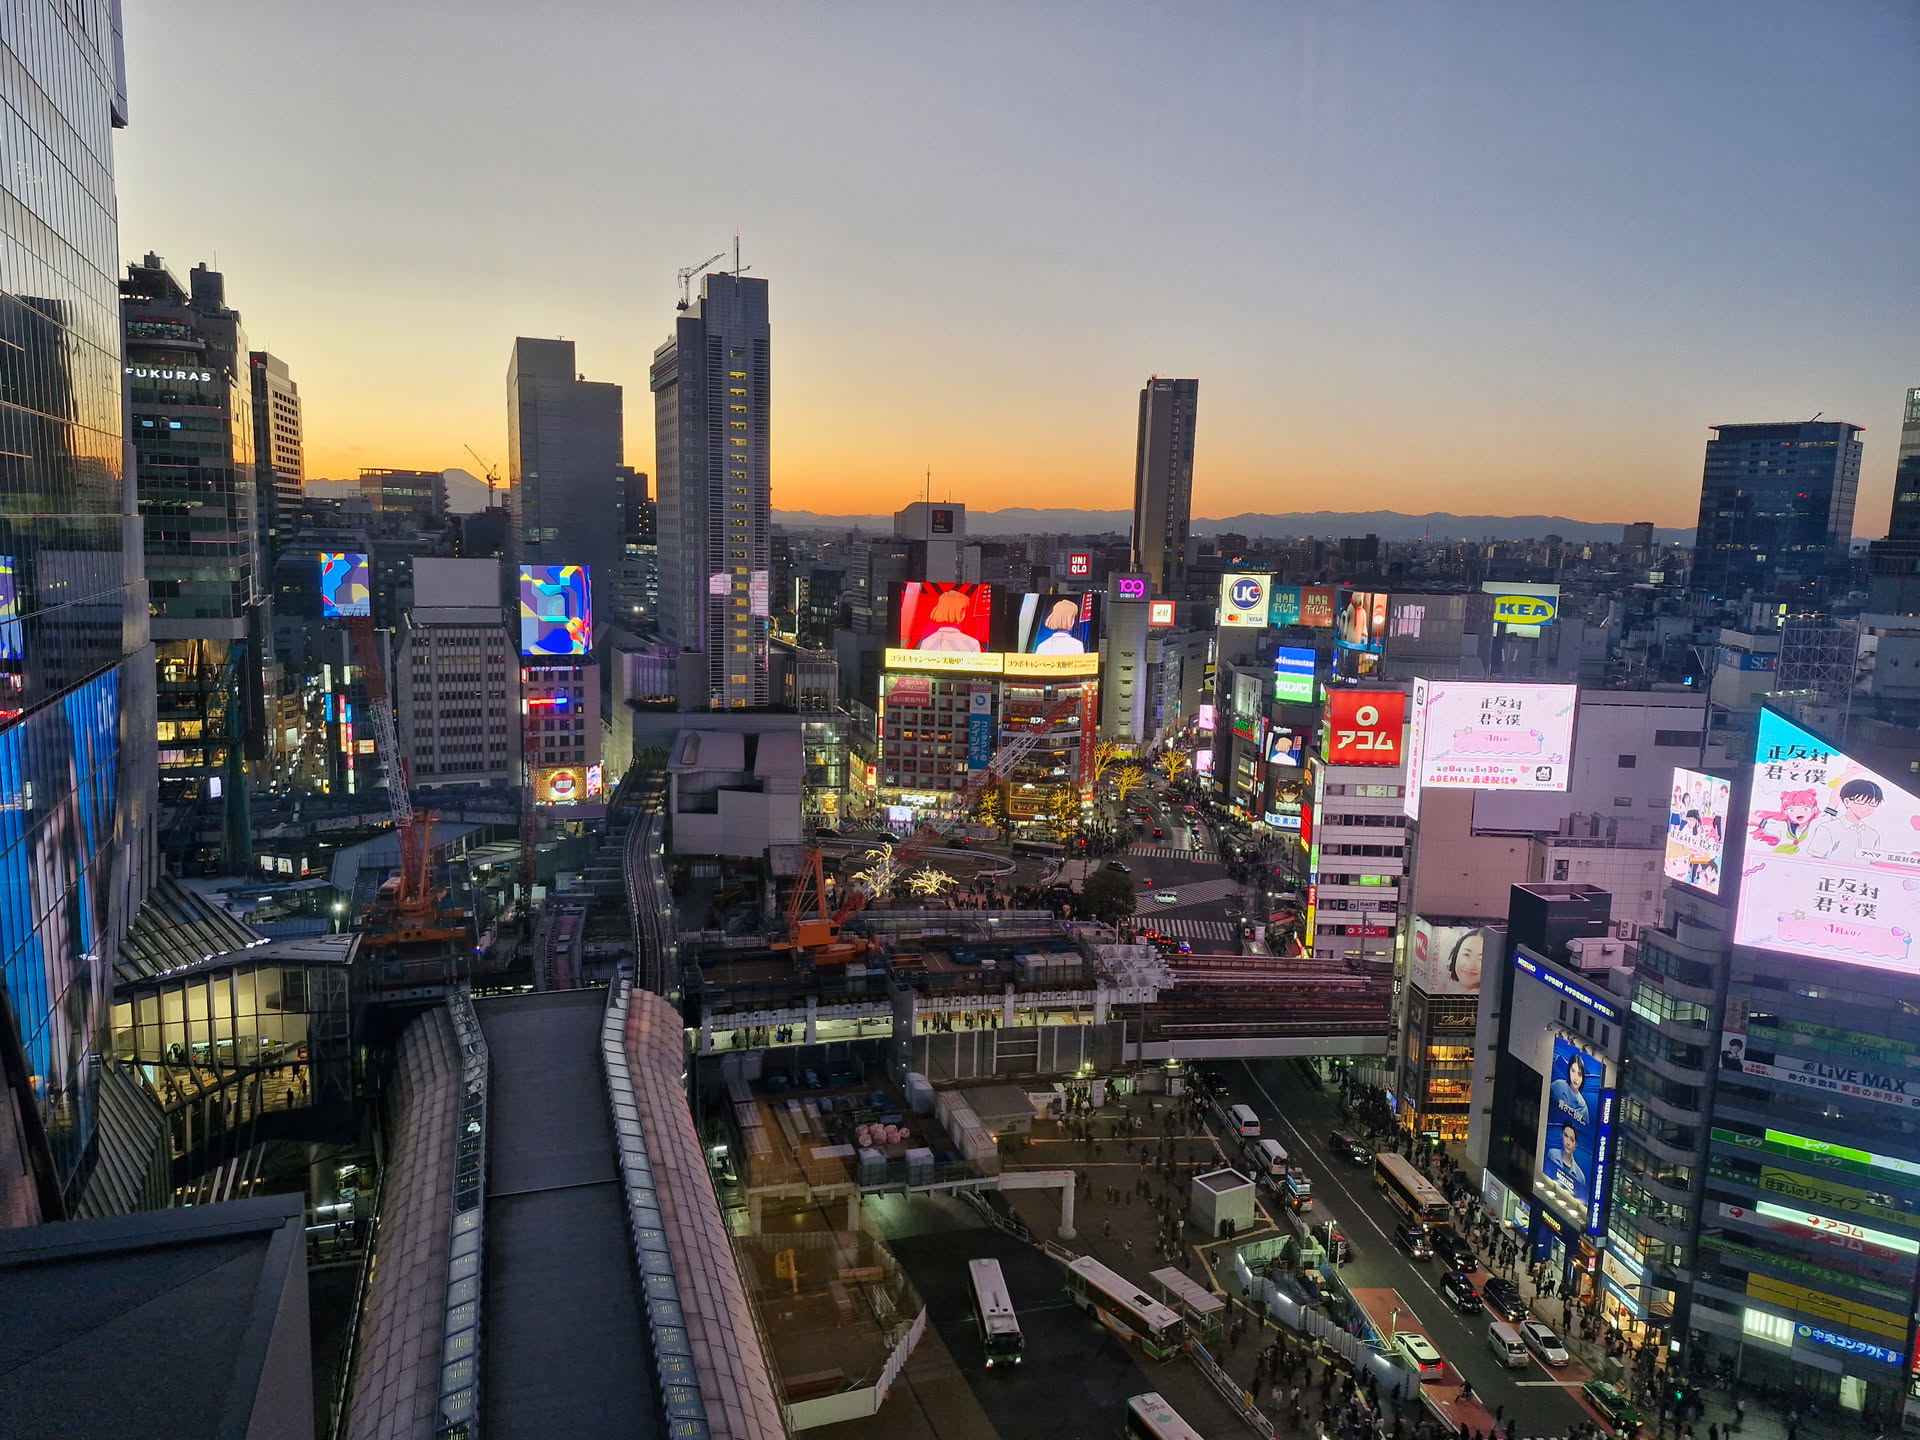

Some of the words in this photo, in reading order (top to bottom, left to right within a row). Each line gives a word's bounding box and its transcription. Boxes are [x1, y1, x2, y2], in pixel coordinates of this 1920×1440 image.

[125, 367, 212, 382] FUKURAS
[1071, 556, 1087, 565] UNI
[1071, 564, 1087, 574] QLO
[1119, 578, 1145, 598] 109
[1232, 585, 1260, 602] UC
[1499, 603, 1549, 617] KEA
[1480, 696, 1522, 710] 正反対
[1478, 713, 1521, 726] 君と僕
[1337, 730, 1394, 750] アコム
[1767, 744, 1829, 764] 正反対
[1764, 765, 1827, 785] 君と僕
[1816, 877, 1881, 899] 正反対
[1813, 896, 1877, 919] 君と僕
[1863, 1072, 1907, 1094] MAX
[1735, 1134, 1763, 1147] レイク
[1805, 1140, 1830, 1151] レイク
[1766, 1179, 1860, 1210] 住まいのリライフ
[1542, 1210, 1561, 1231] MIZUHO
[1824, 1219, 1865, 1238] アコム
[1811, 1229, 1863, 1251] アコム
[1812, 1329, 1885, 1359] 中央コンタクト
